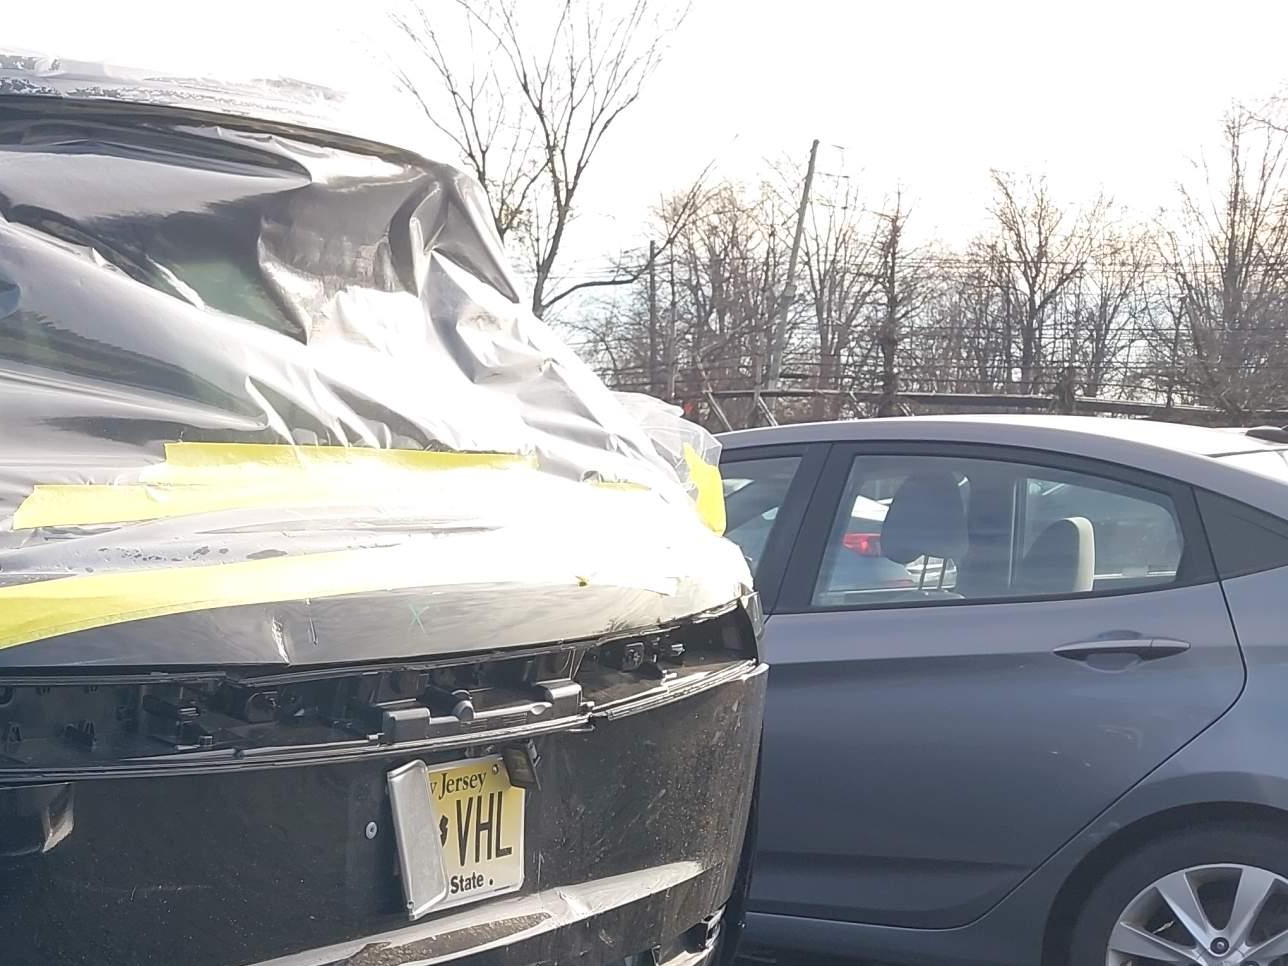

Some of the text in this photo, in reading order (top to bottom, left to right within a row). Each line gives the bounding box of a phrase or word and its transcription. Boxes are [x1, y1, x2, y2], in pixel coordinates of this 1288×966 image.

[438, 772, 487, 800] Jersey
[455, 791, 513, 867] VHL
[450, 871, 484, 894] State
